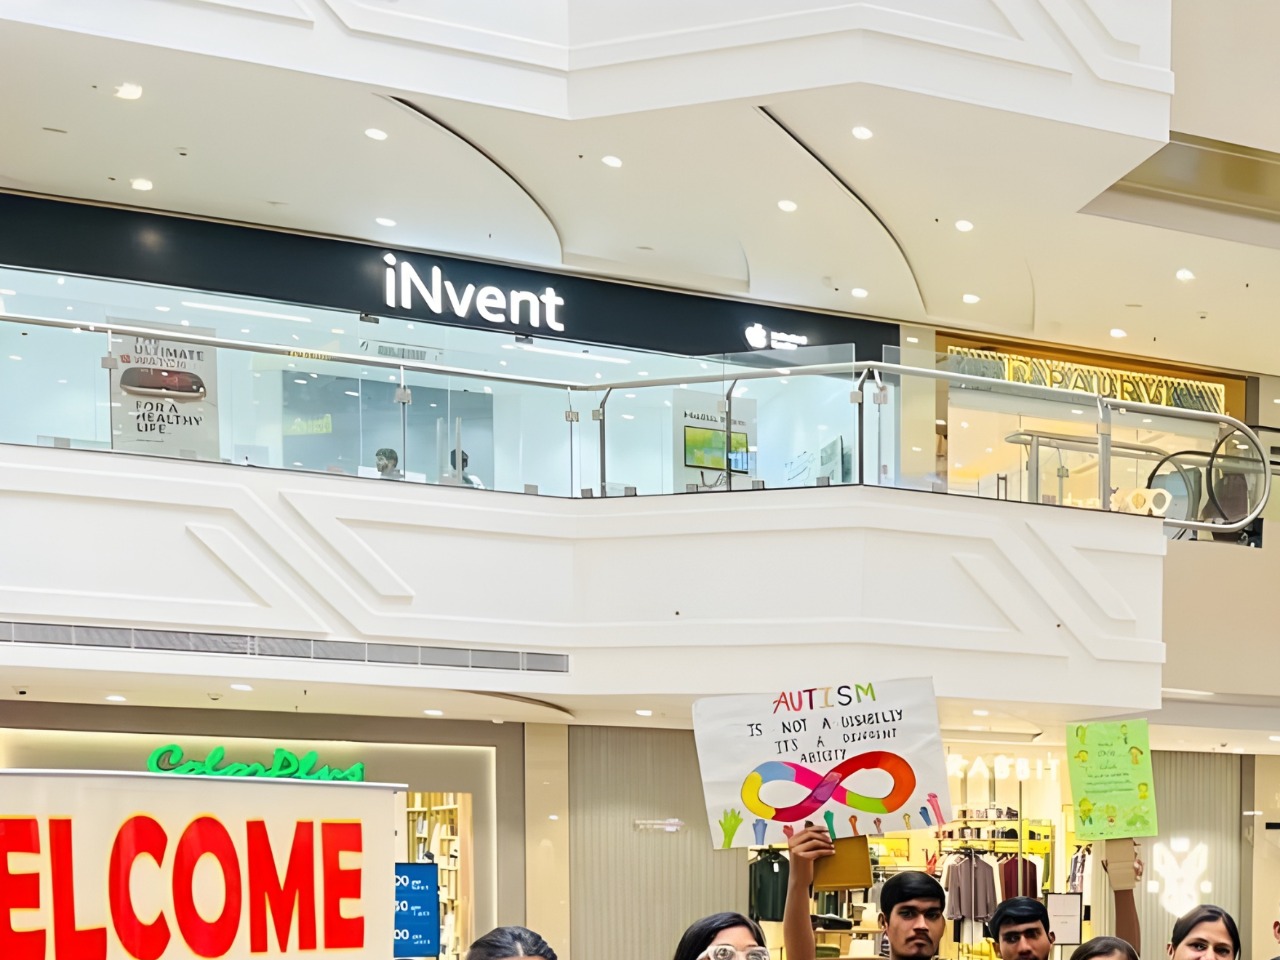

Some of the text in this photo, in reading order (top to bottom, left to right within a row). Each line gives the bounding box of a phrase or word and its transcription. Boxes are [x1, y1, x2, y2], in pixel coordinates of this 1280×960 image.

[384, 253, 565, 332] iNvent
[773, 682, 877, 714] AUTISM
[781, 718, 808, 734] NOT
